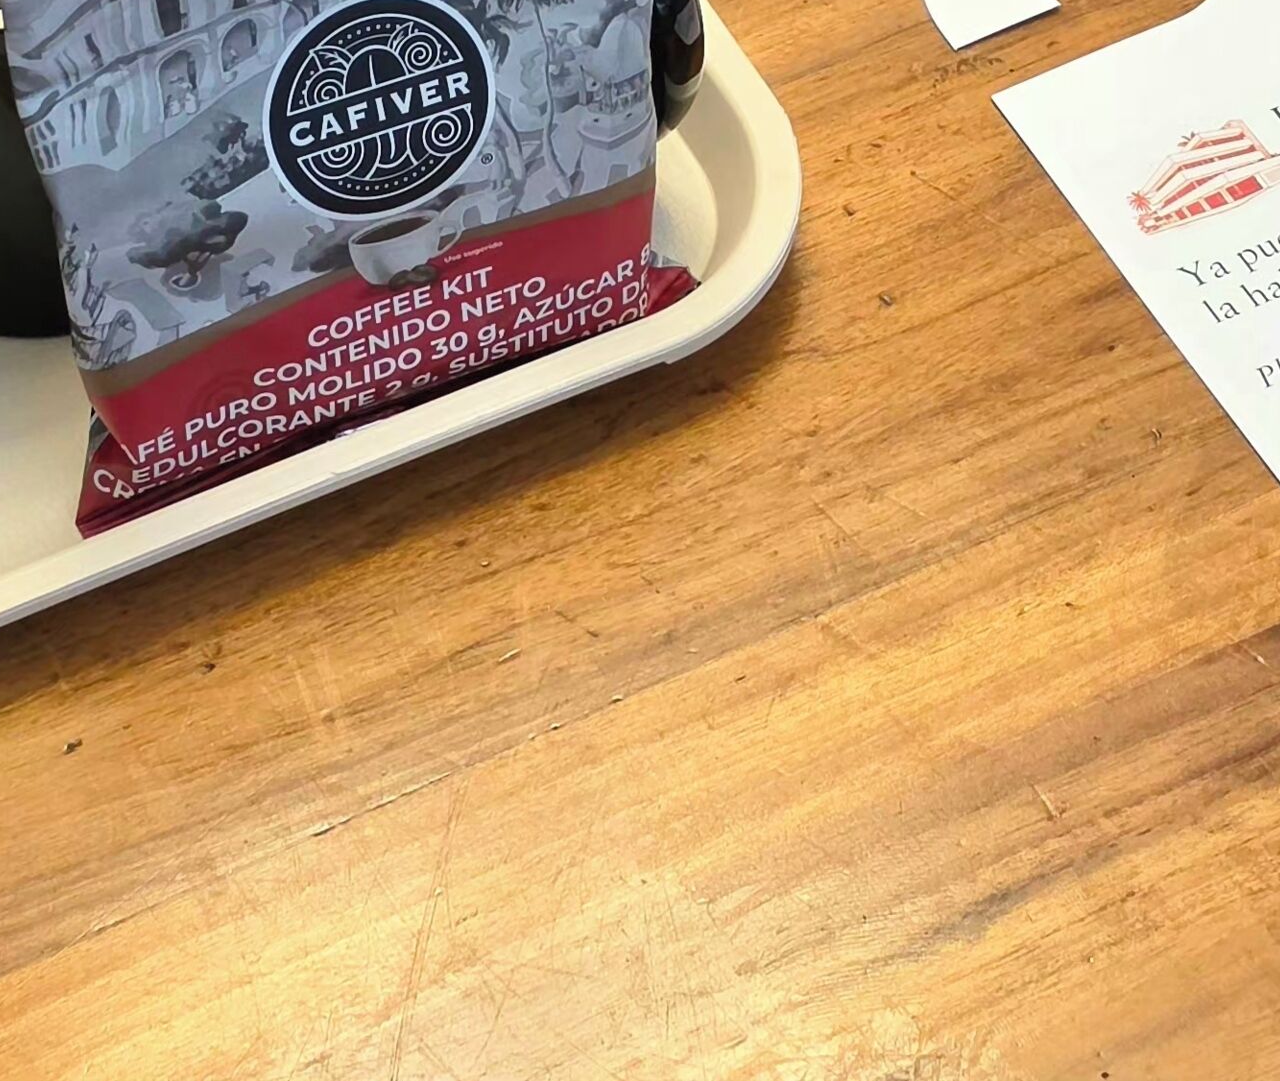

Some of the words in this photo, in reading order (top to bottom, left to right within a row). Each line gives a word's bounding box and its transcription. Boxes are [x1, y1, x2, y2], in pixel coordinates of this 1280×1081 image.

[289, 71, 471, 147] CAFIVER
[308, 286, 433, 348] COFFEE
[442, 266, 494, 300] KIT
[1177, 260, 1230, 287] Ya
[1203, 300, 1240, 323] la
[185, 392, 277, 441] PURO
[289, 347, 422, 406] MOLIDO
[430, 331, 468, 360] 30
[513, 259, 634, 330] AZÚCAR
[253, 309, 450, 387] CONTENIDO
[462, 276, 546, 322] NETO
[131, 388, 376, 483] EDULCORANTE
[449, 297, 613, 374] SUSTITUTO
